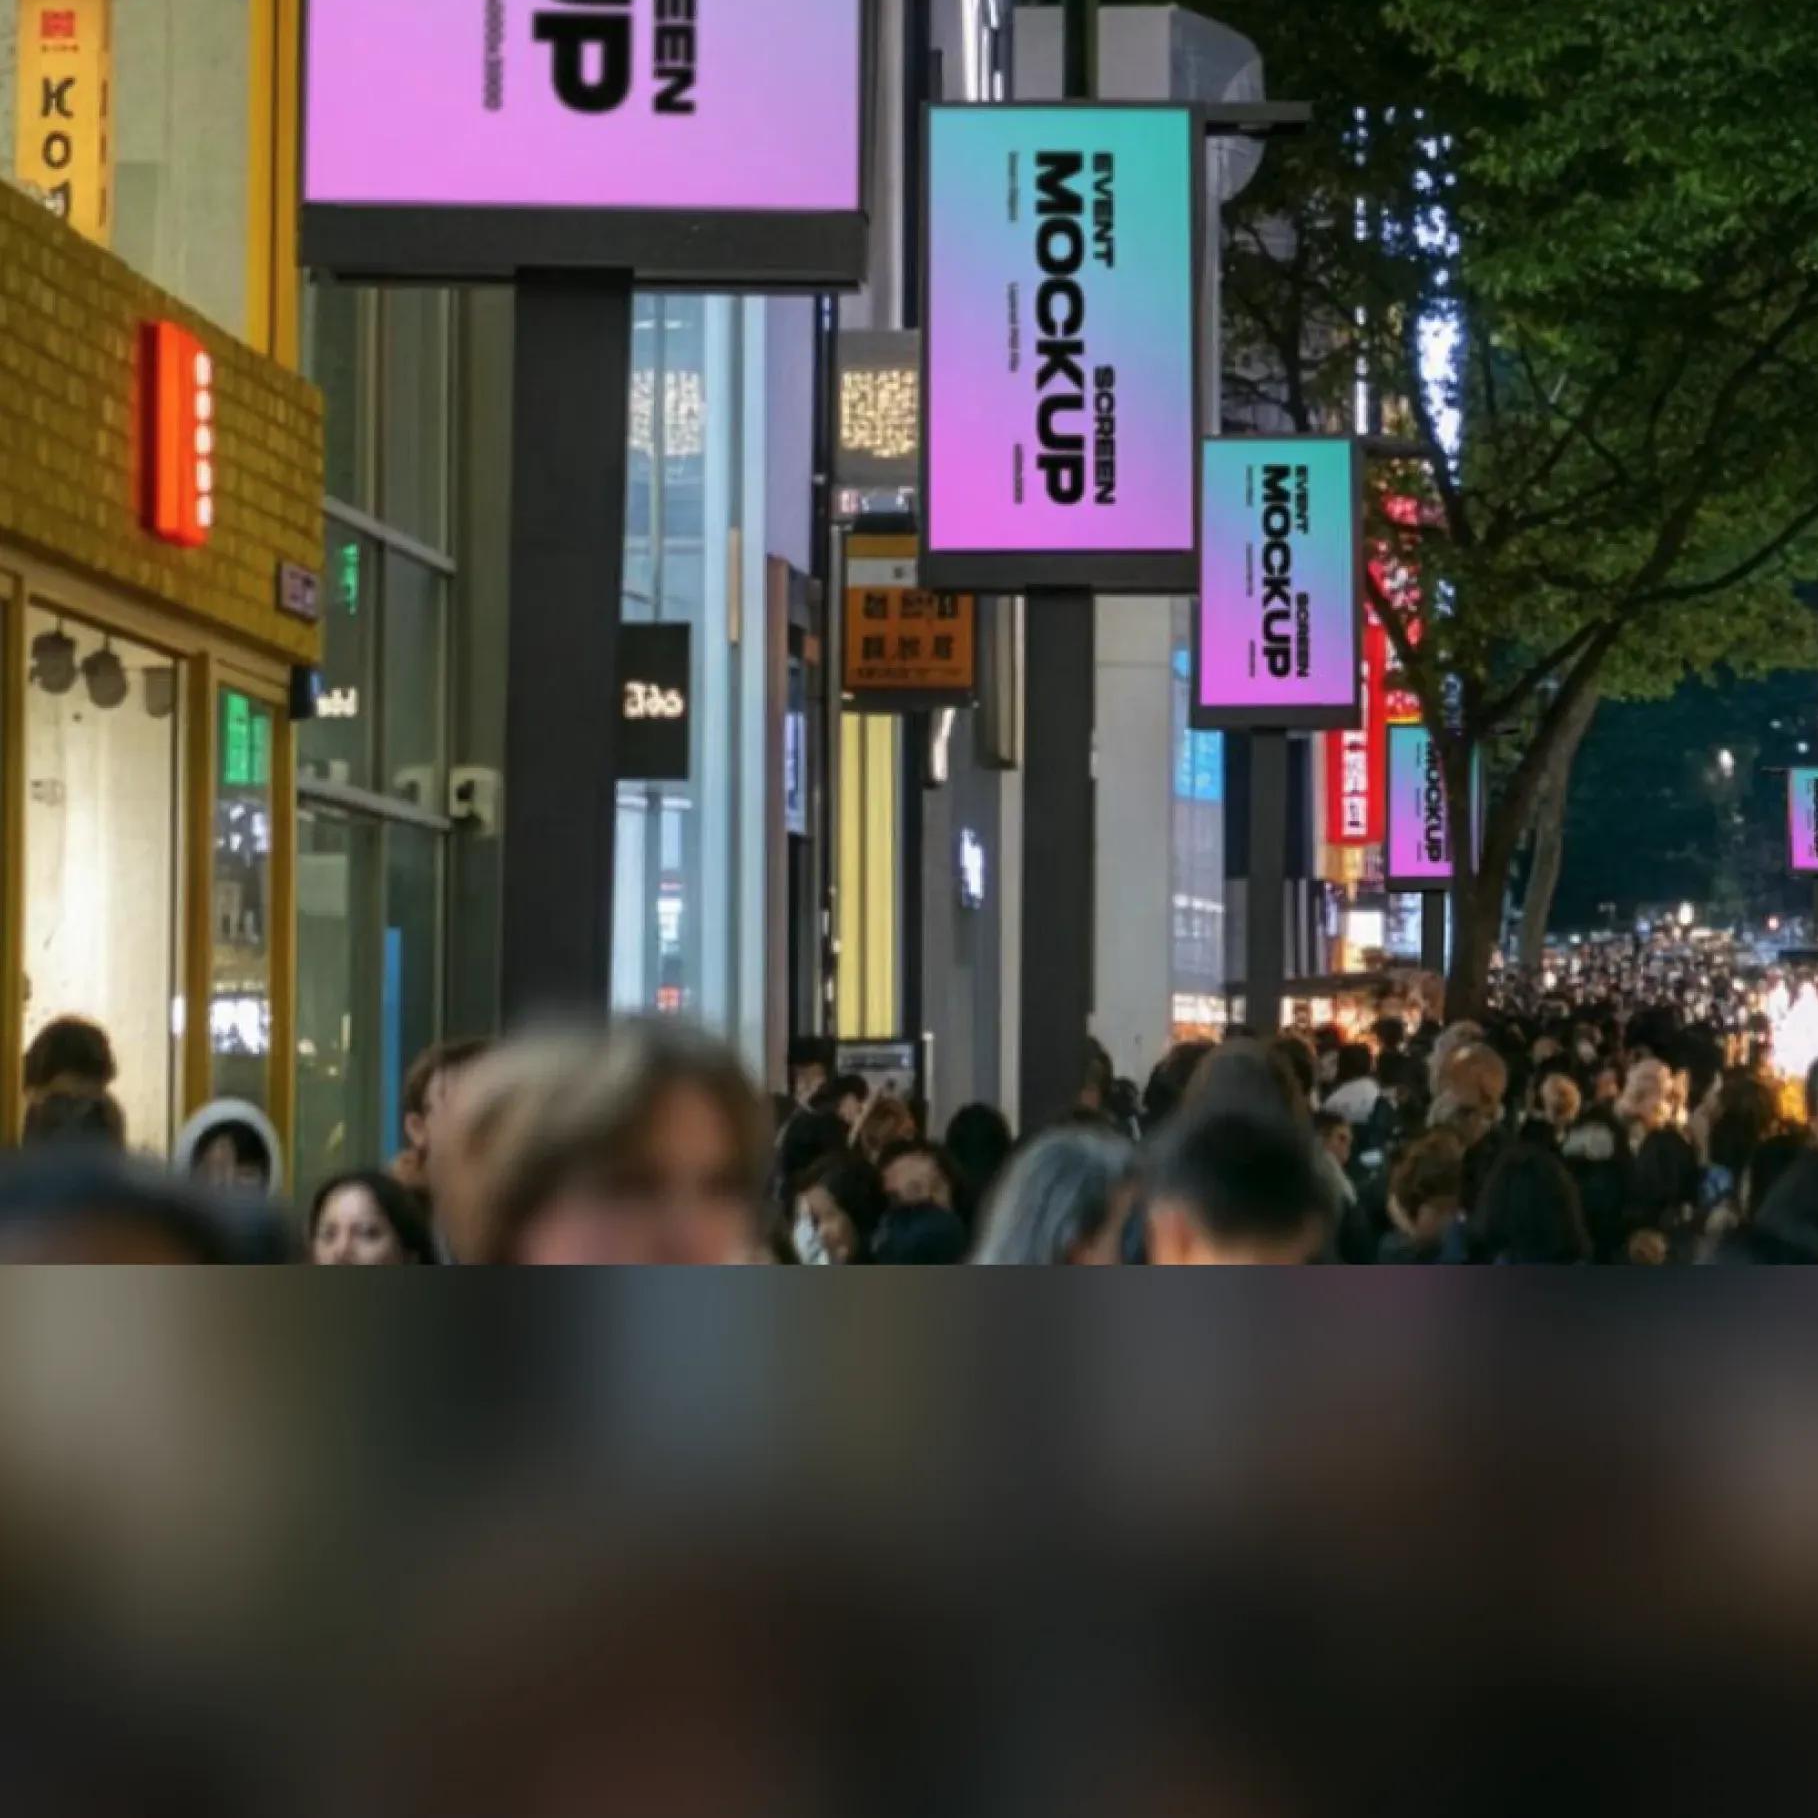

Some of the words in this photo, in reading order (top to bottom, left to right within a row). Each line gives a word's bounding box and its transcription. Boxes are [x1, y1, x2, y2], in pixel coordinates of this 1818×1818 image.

[1092, 152, 1114, 268] EVENT
[1035, 150, 1085, 505] MOCKUP
[1094, 365, 1116, 505] SCREEN
[1262, 463, 1292, 678] MOCKUP
